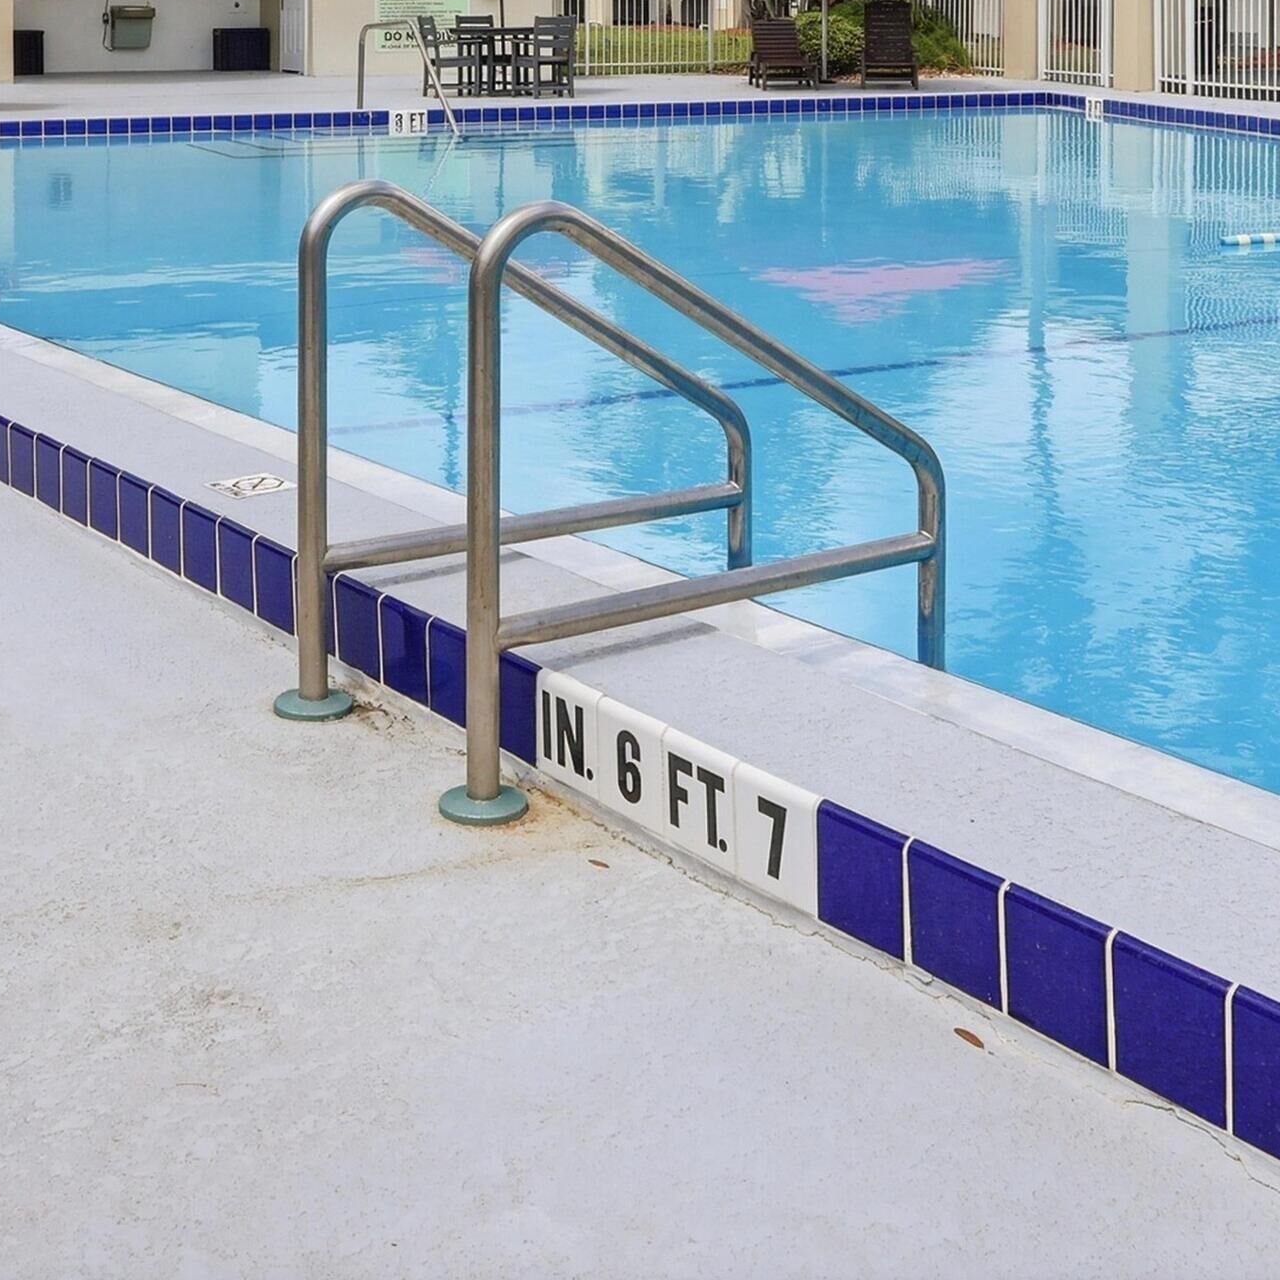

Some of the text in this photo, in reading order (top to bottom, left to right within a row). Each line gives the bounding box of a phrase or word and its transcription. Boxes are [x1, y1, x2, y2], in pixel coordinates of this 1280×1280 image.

[384, 31, 402, 41] DO
[395, 113, 403, 128] 3
[542, 689, 787, 880] IN. 6 FT. 7
